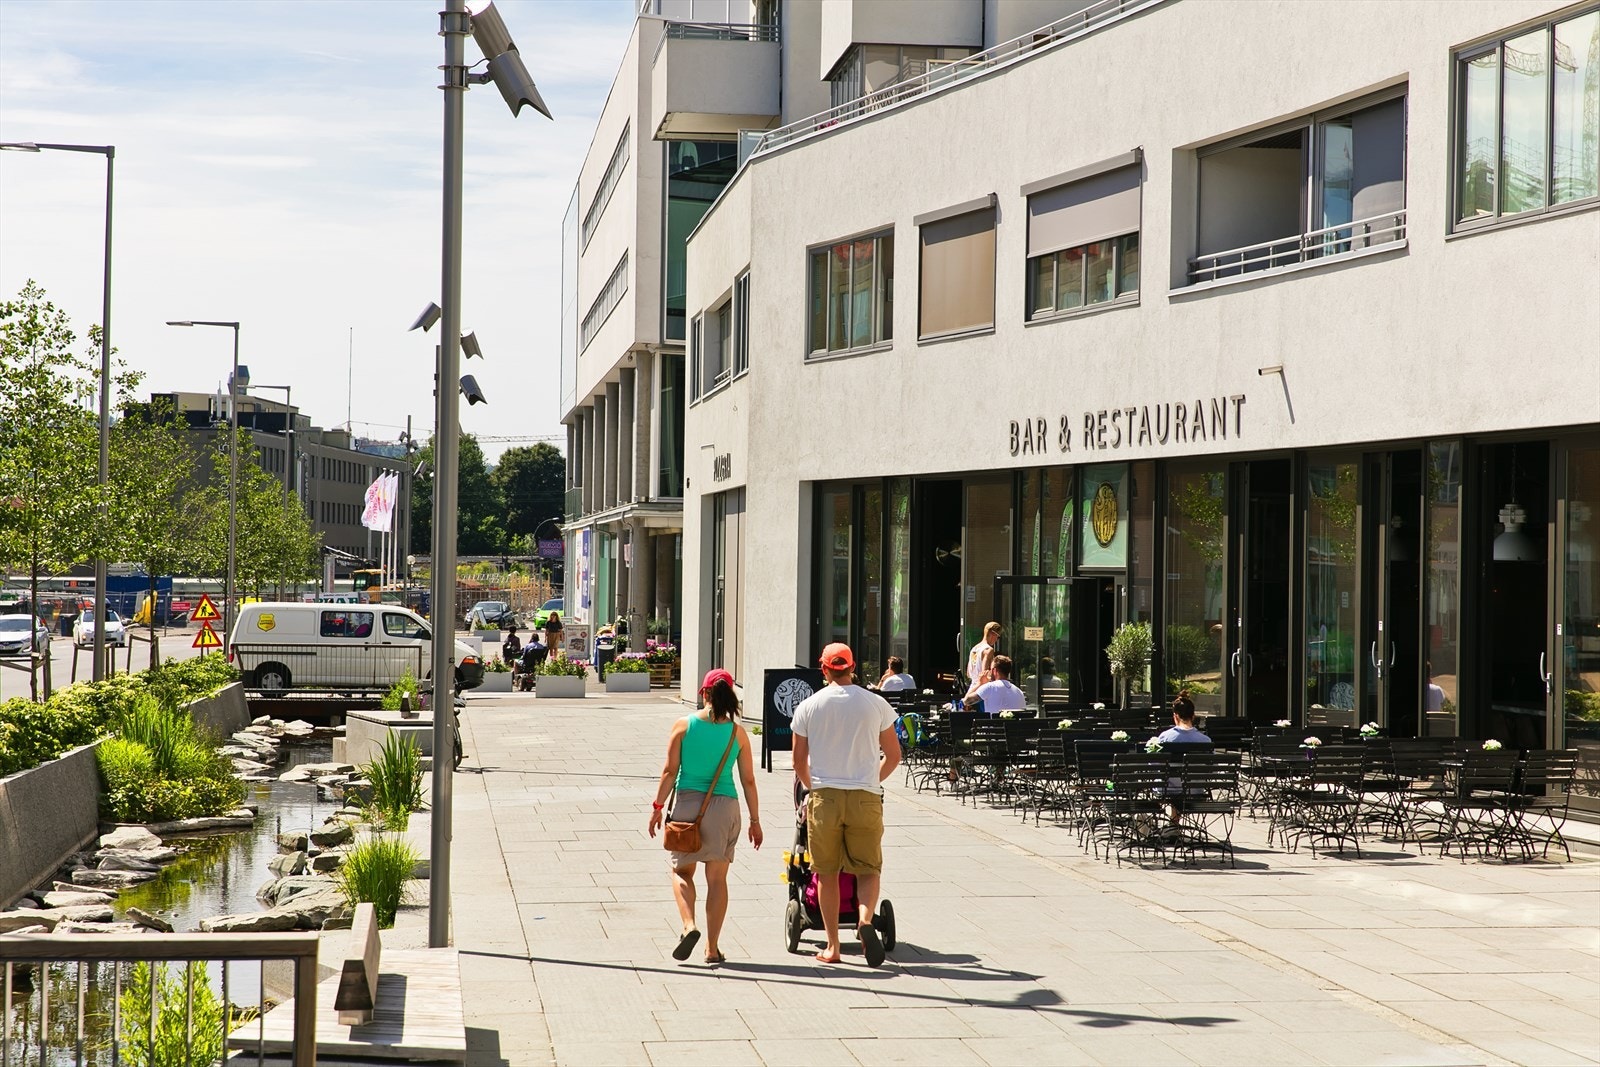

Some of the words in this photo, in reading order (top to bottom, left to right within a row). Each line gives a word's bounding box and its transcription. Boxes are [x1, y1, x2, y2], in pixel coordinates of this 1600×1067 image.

[1009, 416, 1048, 457] BAR
[1058, 414, 1072, 453] &
[1083, 394, 1246, 450] RESTAURANT
